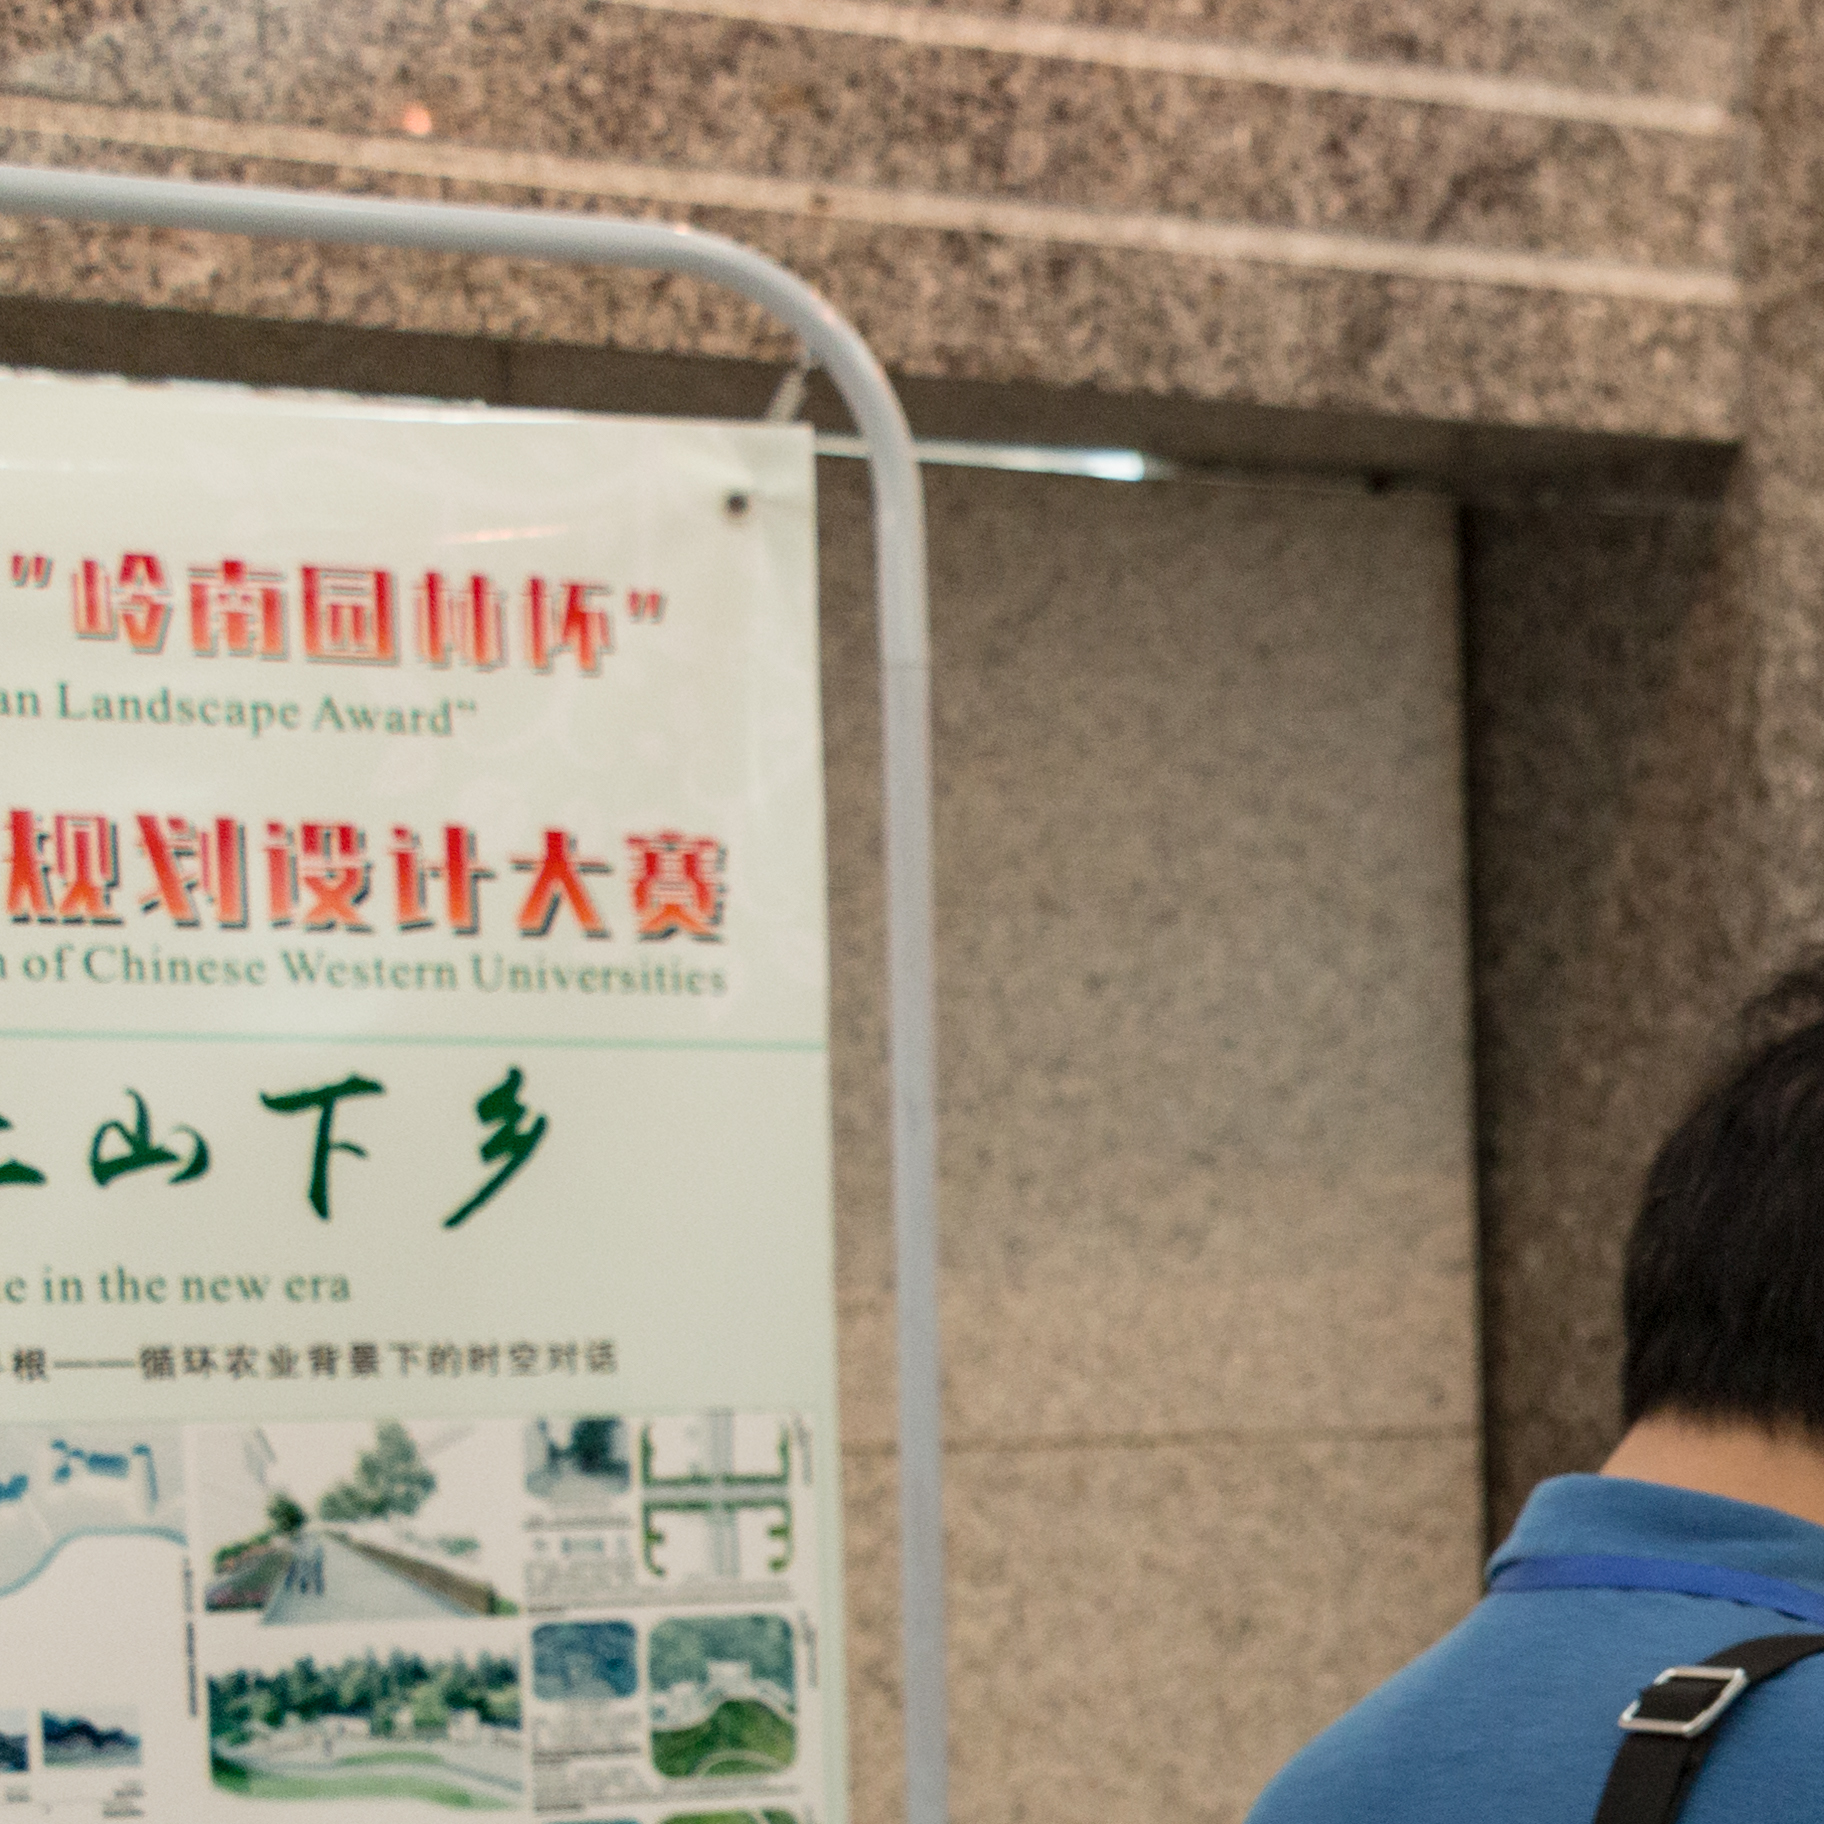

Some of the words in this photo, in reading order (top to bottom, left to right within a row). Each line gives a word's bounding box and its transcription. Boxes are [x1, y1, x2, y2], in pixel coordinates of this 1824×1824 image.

[56, 683, 300, 739] Landscape
[23, 945, 75, 981] of
[84, 945, 269, 987] Chinese
[281, 950, 462, 992] Western
[469, 955, 728, 999] Universities
[43, 1263, 84, 1306] in
[97, 1263, 168, 1306] the
[180, 1274, 272, 1306] new
[283, 1274, 352, 1306] era
